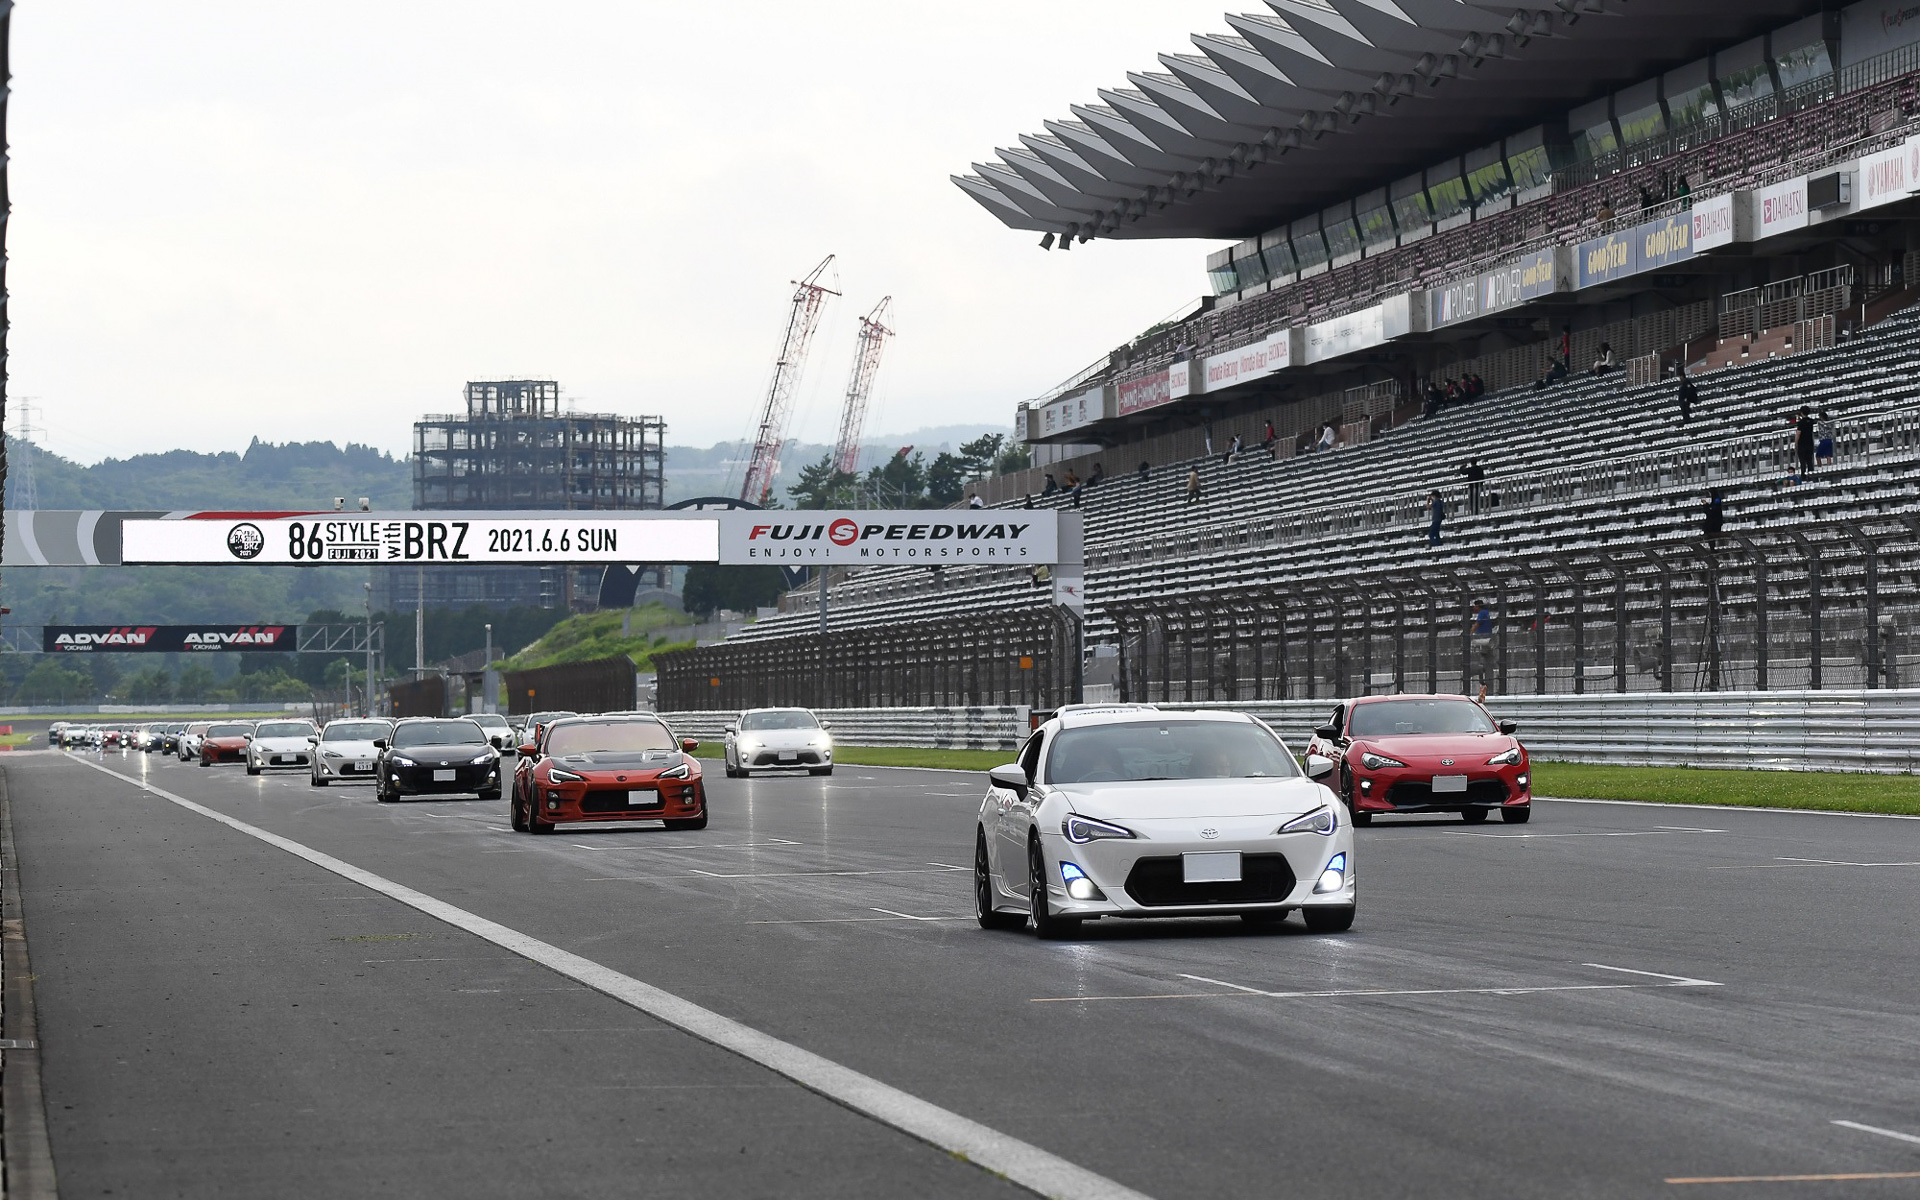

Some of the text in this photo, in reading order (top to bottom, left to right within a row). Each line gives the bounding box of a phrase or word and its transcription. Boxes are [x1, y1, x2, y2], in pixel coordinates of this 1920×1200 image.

[1876, 157, 1905, 196] YAMAHA
[1773, 189, 1804, 221] DAIHATSU
[1702, 206, 1731, 237] DAIHATSU
[1645, 218, 1688, 262] GOODYEAR
[1588, 236, 1628, 278] GOODYEAR
[1497, 268, 1521, 306] POWER
[1522, 257, 1552, 291] GOODYEAR
[1452, 282, 1476, 318] POWER
[1268, 341, 1288, 361] HONDA
[1170, 371, 1188, 389] HONDA
[289, 522, 324, 559] 86
[326, 522, 380, 542] STYLE
[382, 522, 401, 559] with
[404, 522, 469, 559] BRZ
[488, 528, 617, 552] 2021.6.6 SUN
[748, 518, 1030, 546] FUJI SPEEDWAY
[328, 549, 377, 559] FUJI 2021
[749, 547, 1027, 557] ENJOY! MOTORSPORTS
[54, 633, 146, 644] ADVAN
[183, 632, 274, 643] ADVAN
